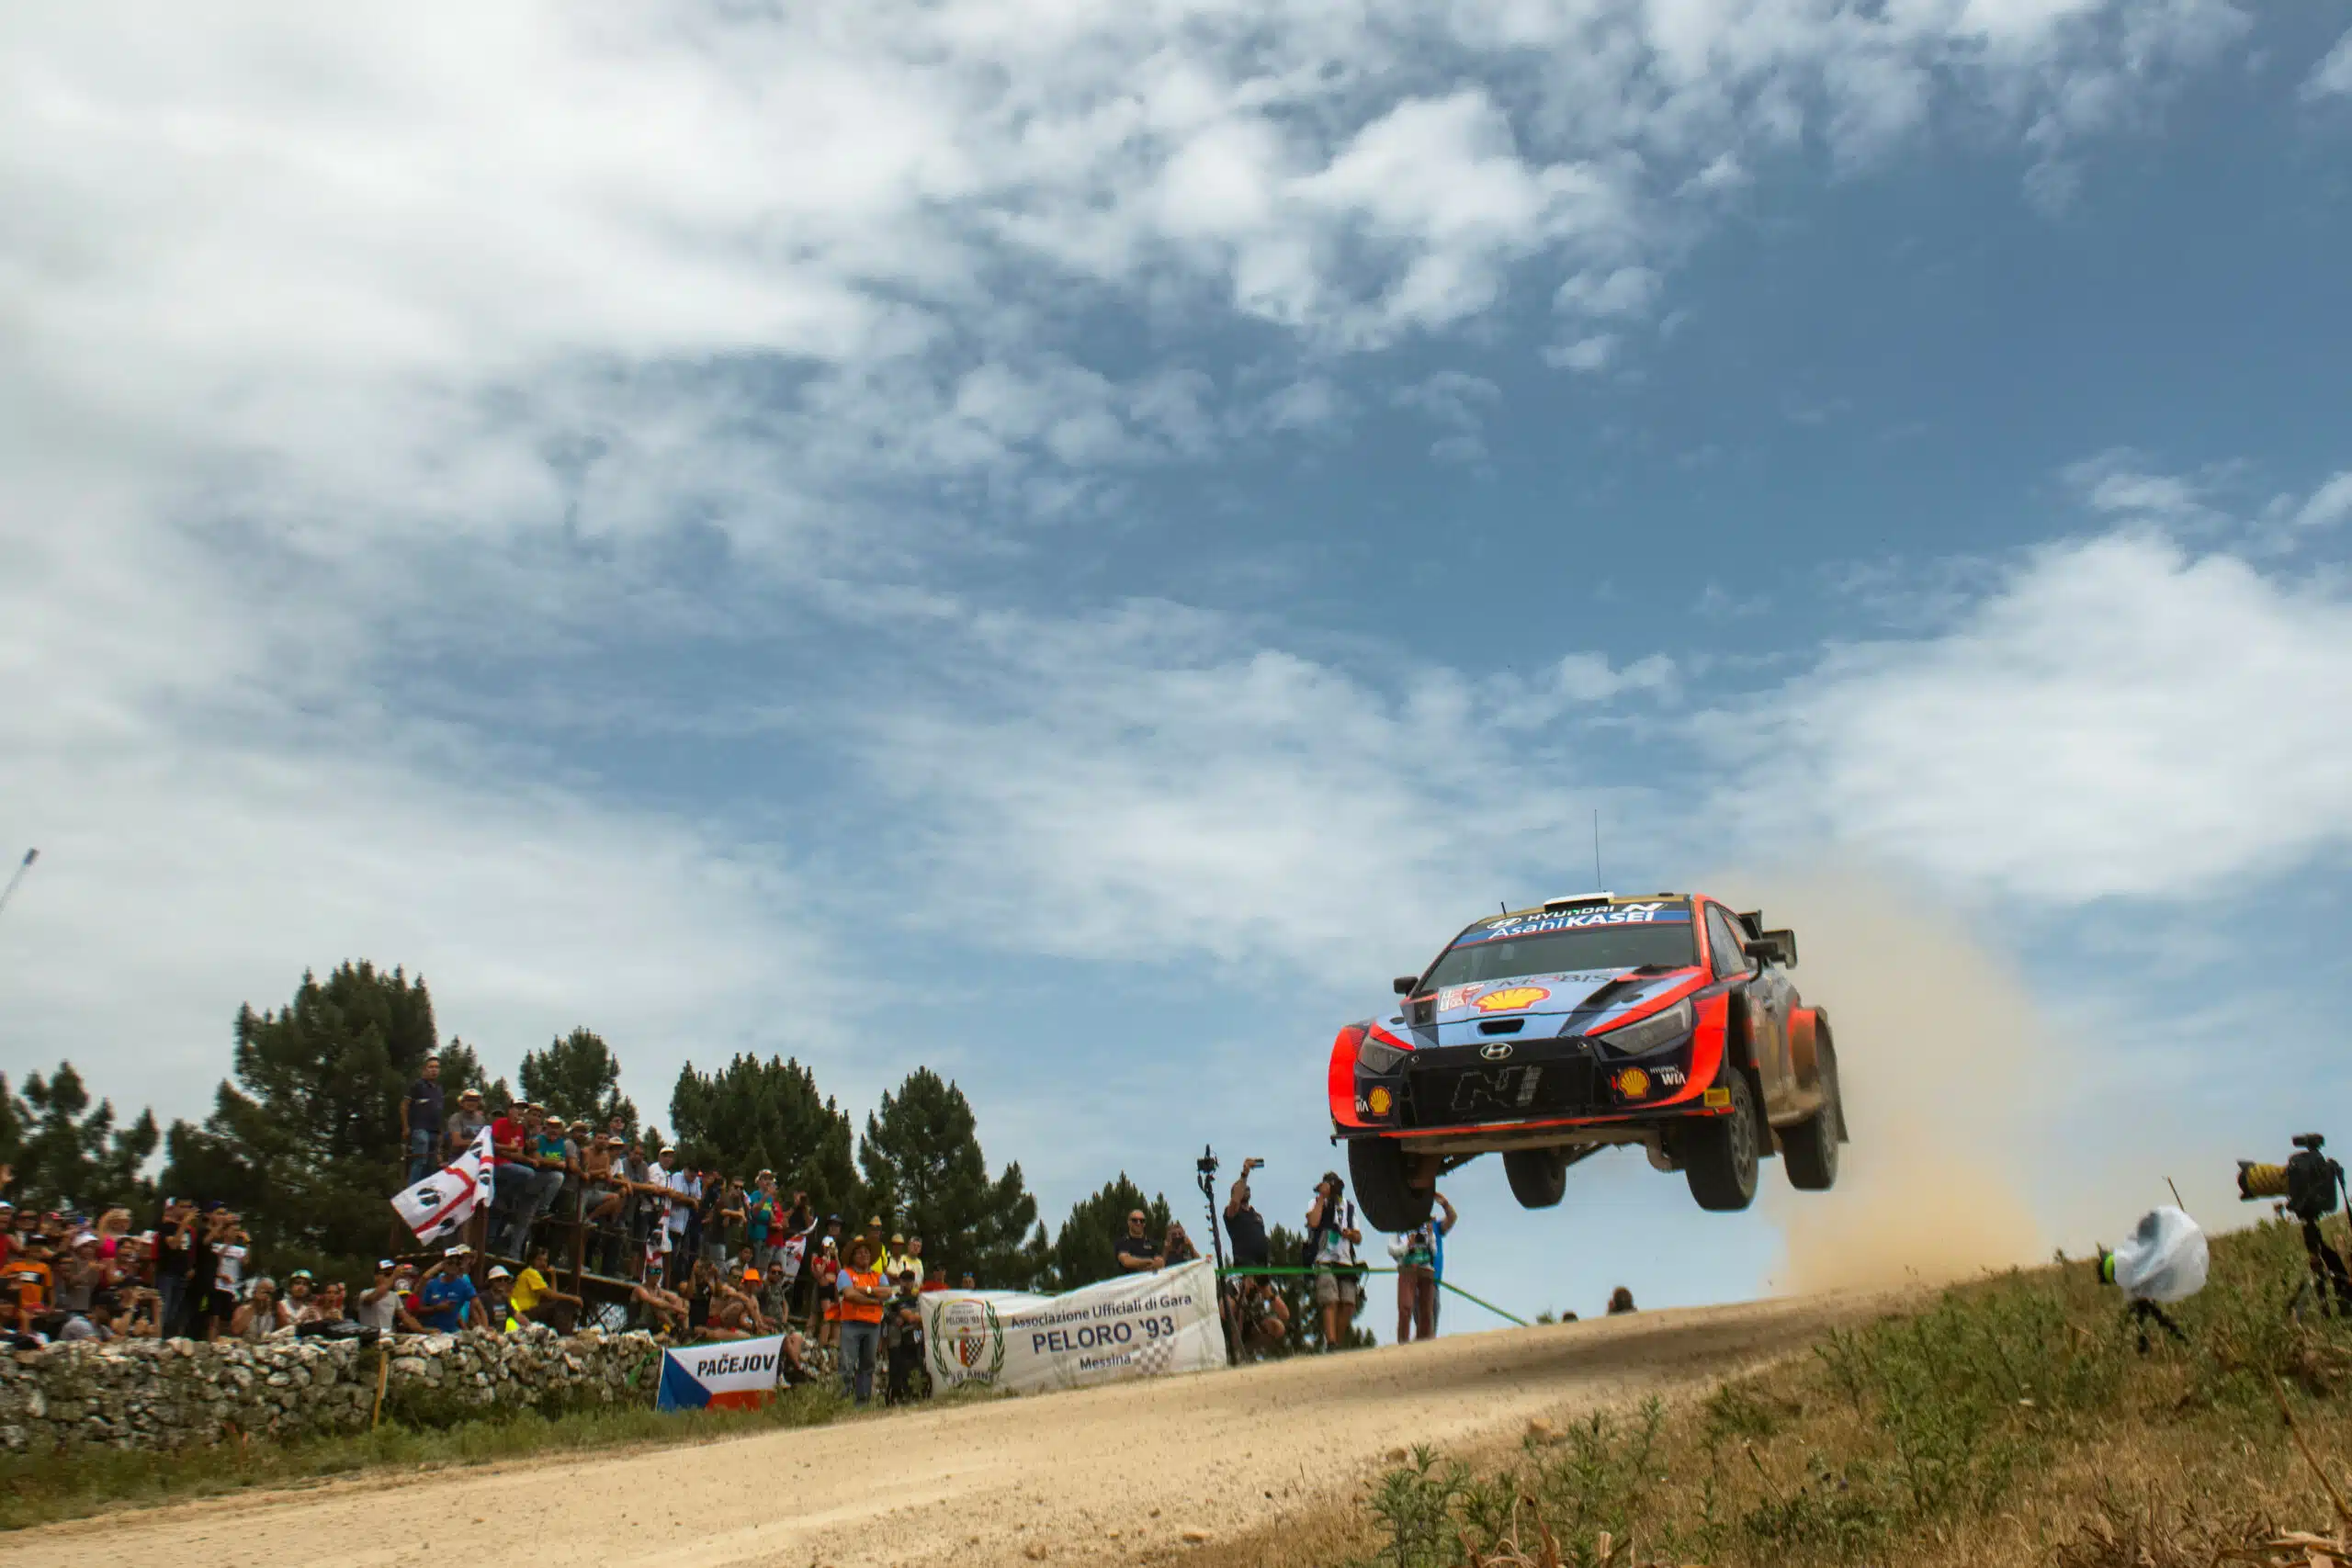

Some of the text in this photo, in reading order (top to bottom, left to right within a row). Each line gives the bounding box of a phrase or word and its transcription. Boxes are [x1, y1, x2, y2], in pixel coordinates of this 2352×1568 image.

[1661, 1071, 1687, 1086] WIA
[1011, 1293, 1193, 1329] Associazione Ufficiali di Gara
[1032, 1314, 1175, 1355] PELORO '93
[696, 1353, 777, 1377] PAČEJOV
[1080, 1354, 1132, 1371] Messina
